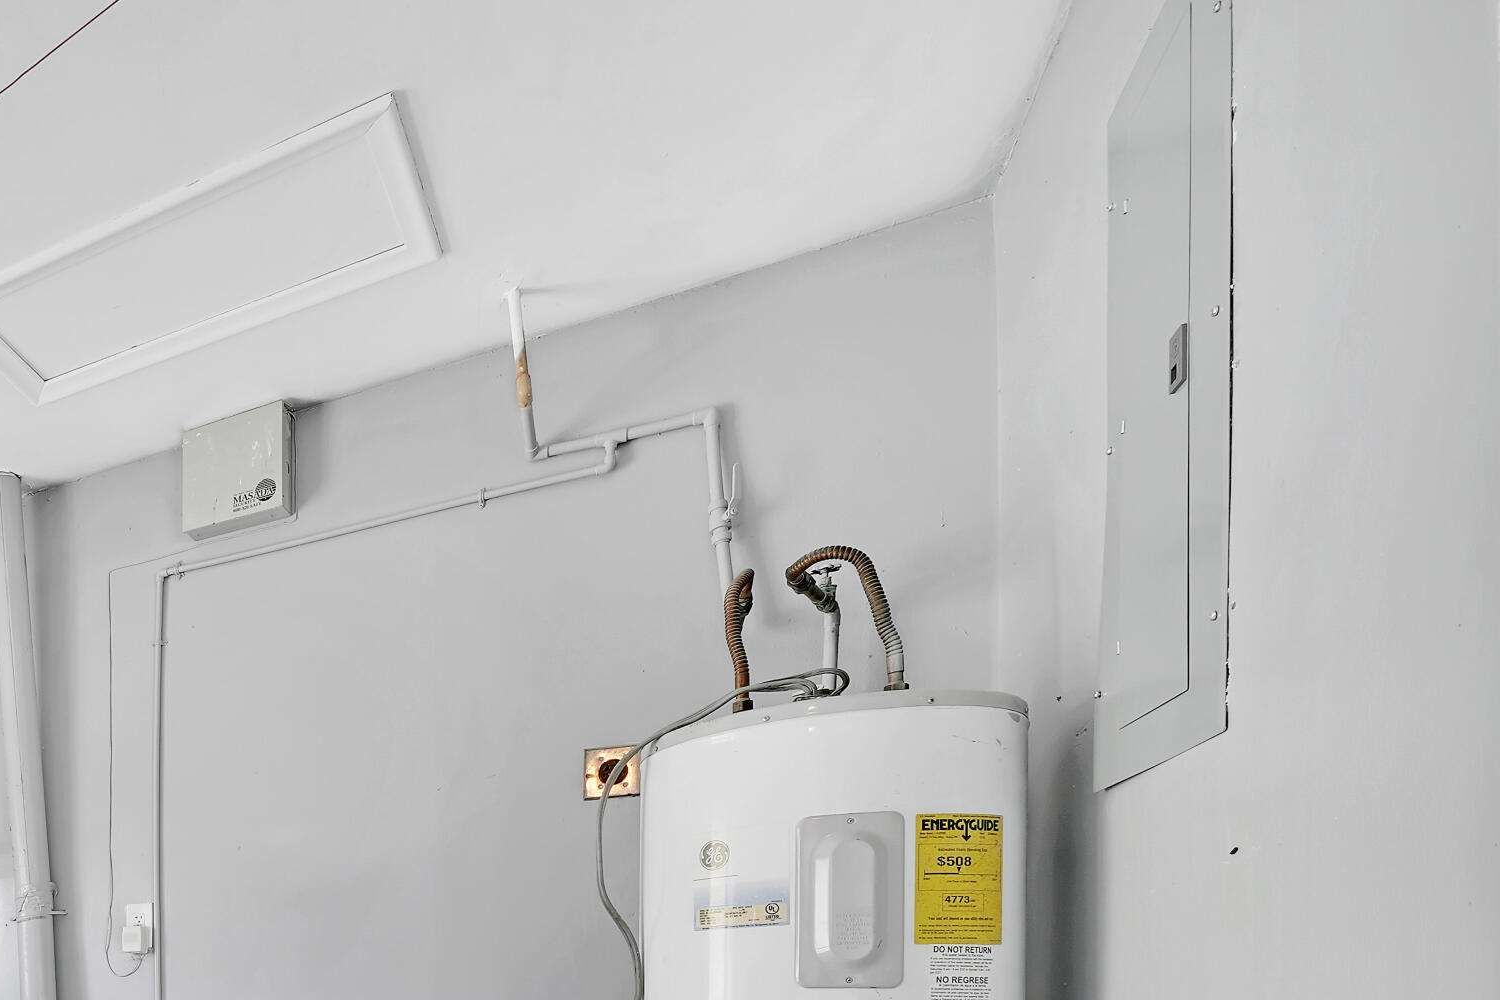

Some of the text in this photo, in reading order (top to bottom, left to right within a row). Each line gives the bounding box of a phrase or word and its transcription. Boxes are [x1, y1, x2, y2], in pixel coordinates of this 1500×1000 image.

[233, 487, 276, 504] MASADA
[922, 819, 999, 832] ENERGYGUIDE
[937, 856, 972, 867] $508
[945, 896, 970, 904] 4773
[965, 946, 992, 954] RETURN
[936, 976, 989, 985] NO REGRESE
